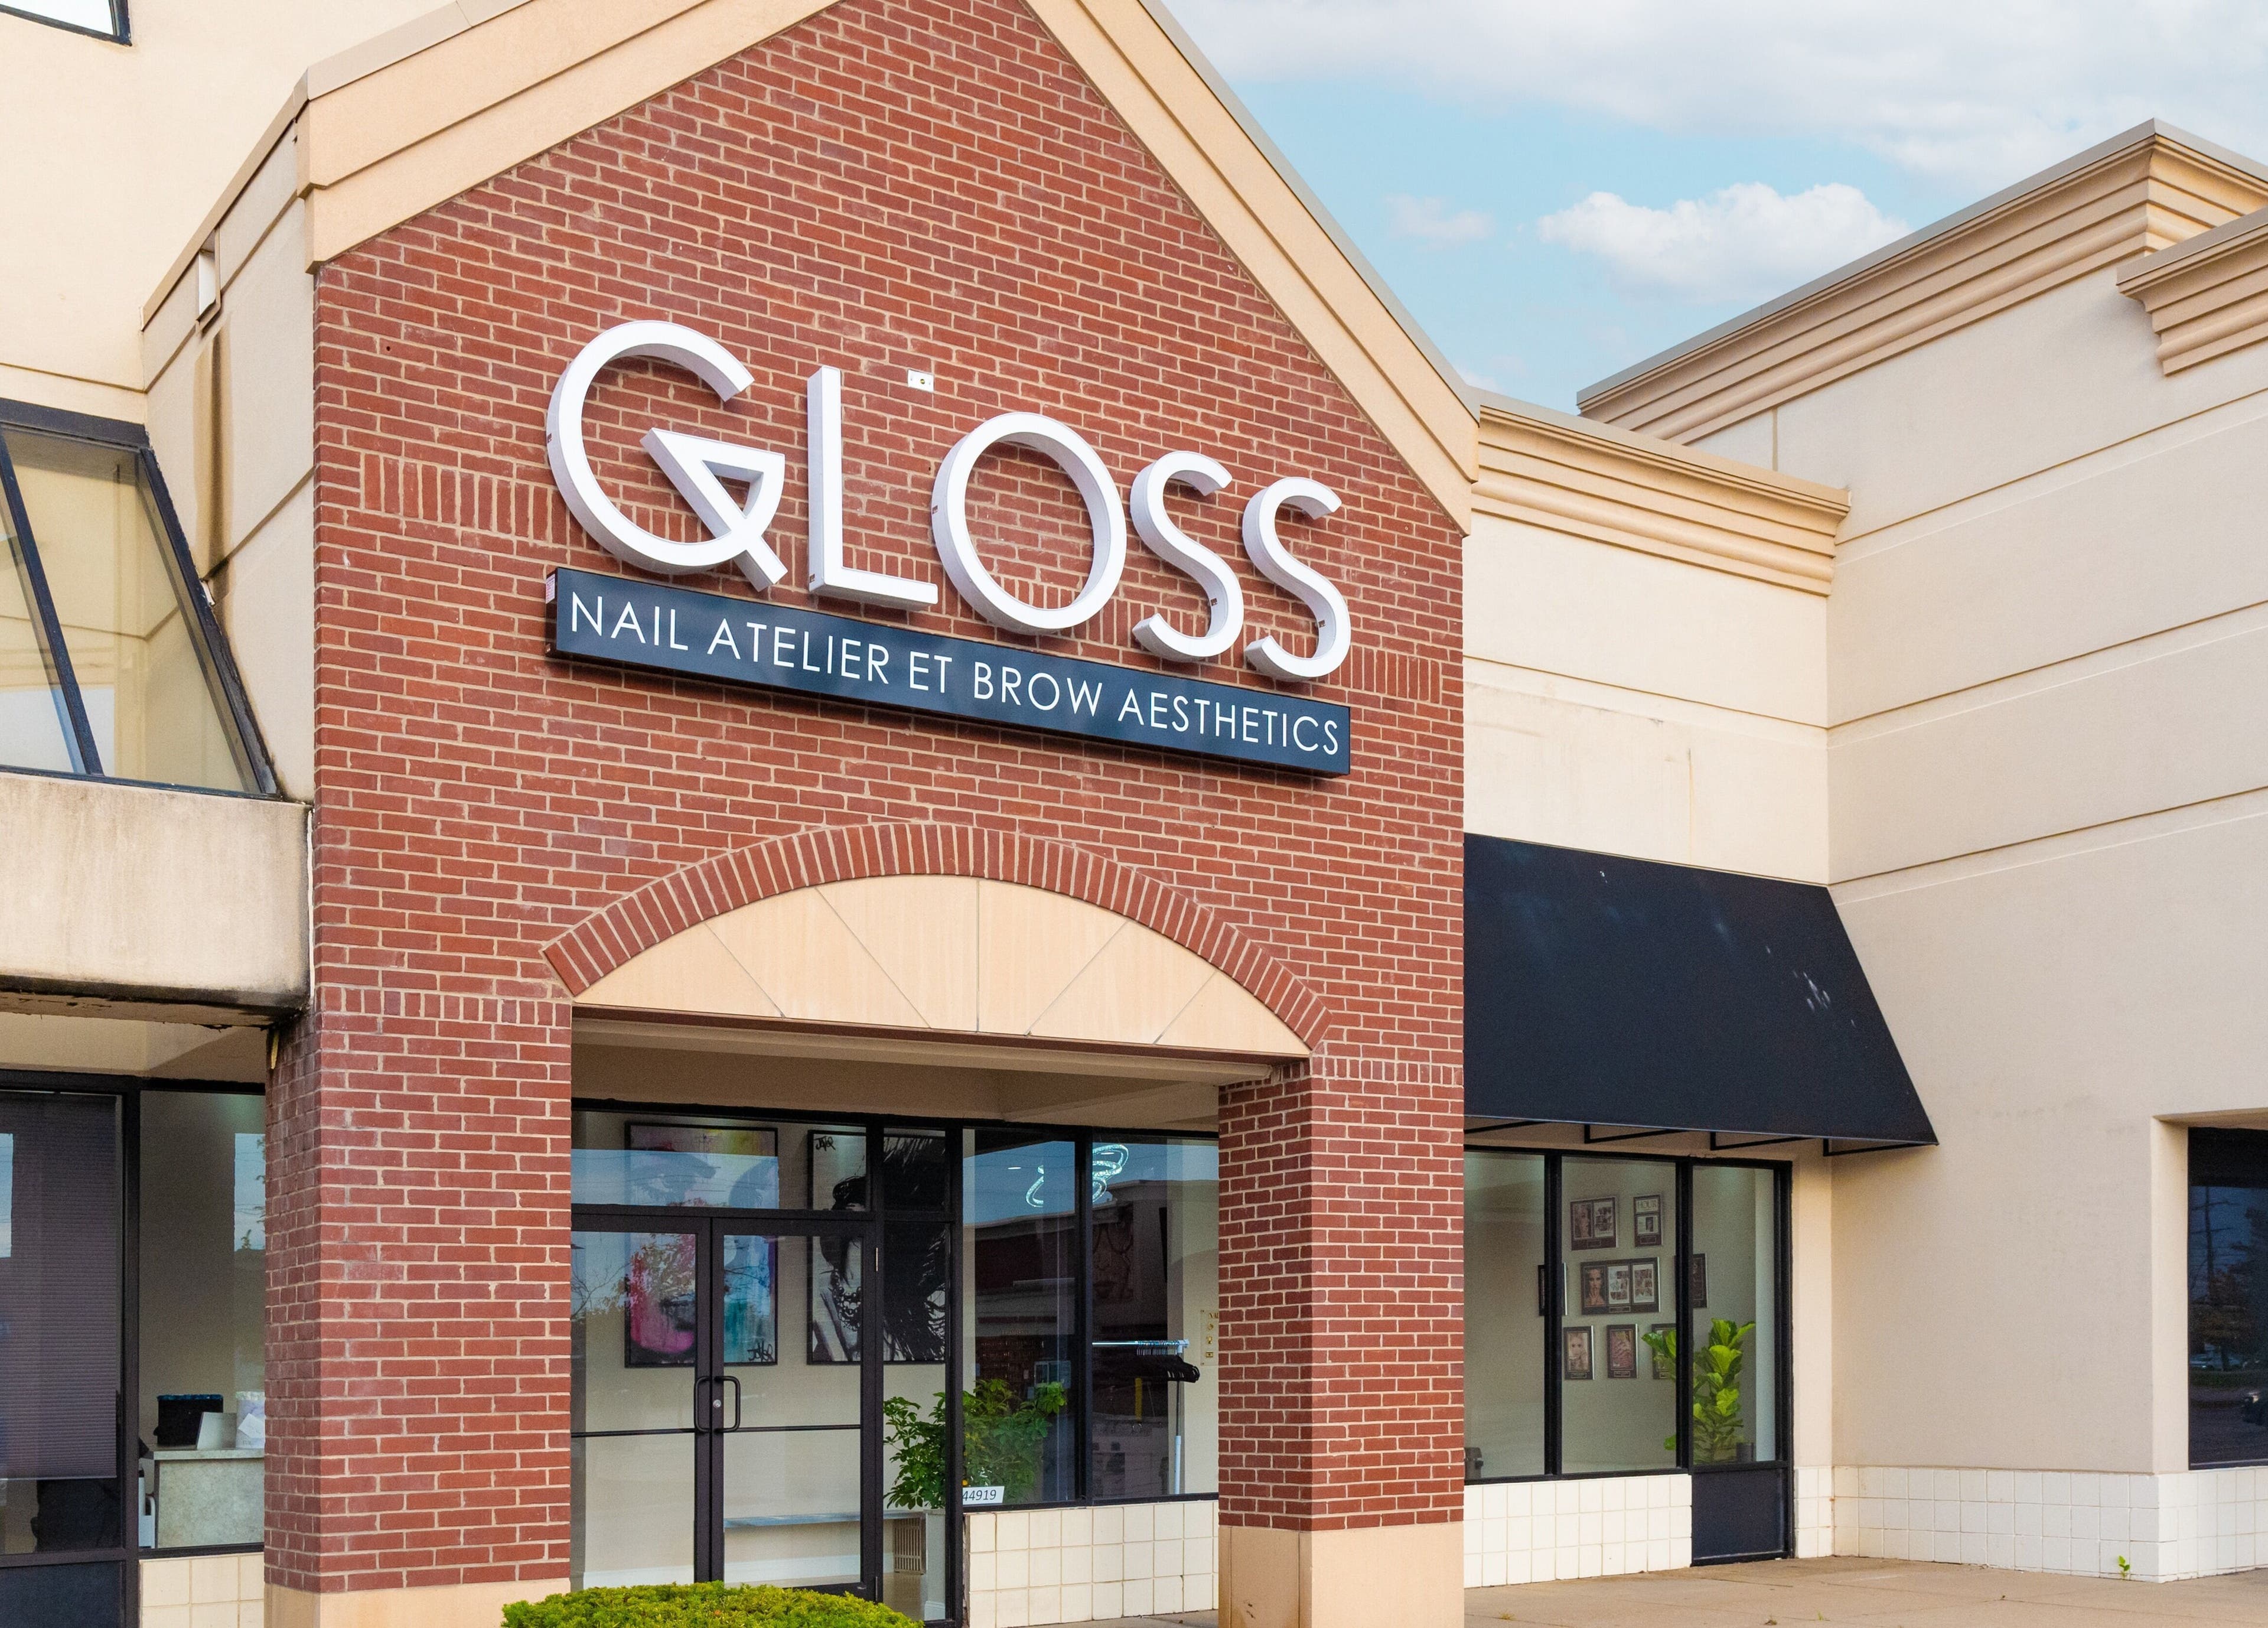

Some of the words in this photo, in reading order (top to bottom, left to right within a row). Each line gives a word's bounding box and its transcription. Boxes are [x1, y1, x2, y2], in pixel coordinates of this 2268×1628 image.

[546, 320, 1351, 681] GLOSS
[571, 591, 689, 652] NAIL
[706, 617, 890, 685] ATELIER
[909, 650, 953, 694] ET
[973, 660, 1103, 718] BROW
[1117, 688, 1339, 756] AESTHETICS
[962, 1489, 997, 1502] 44919
